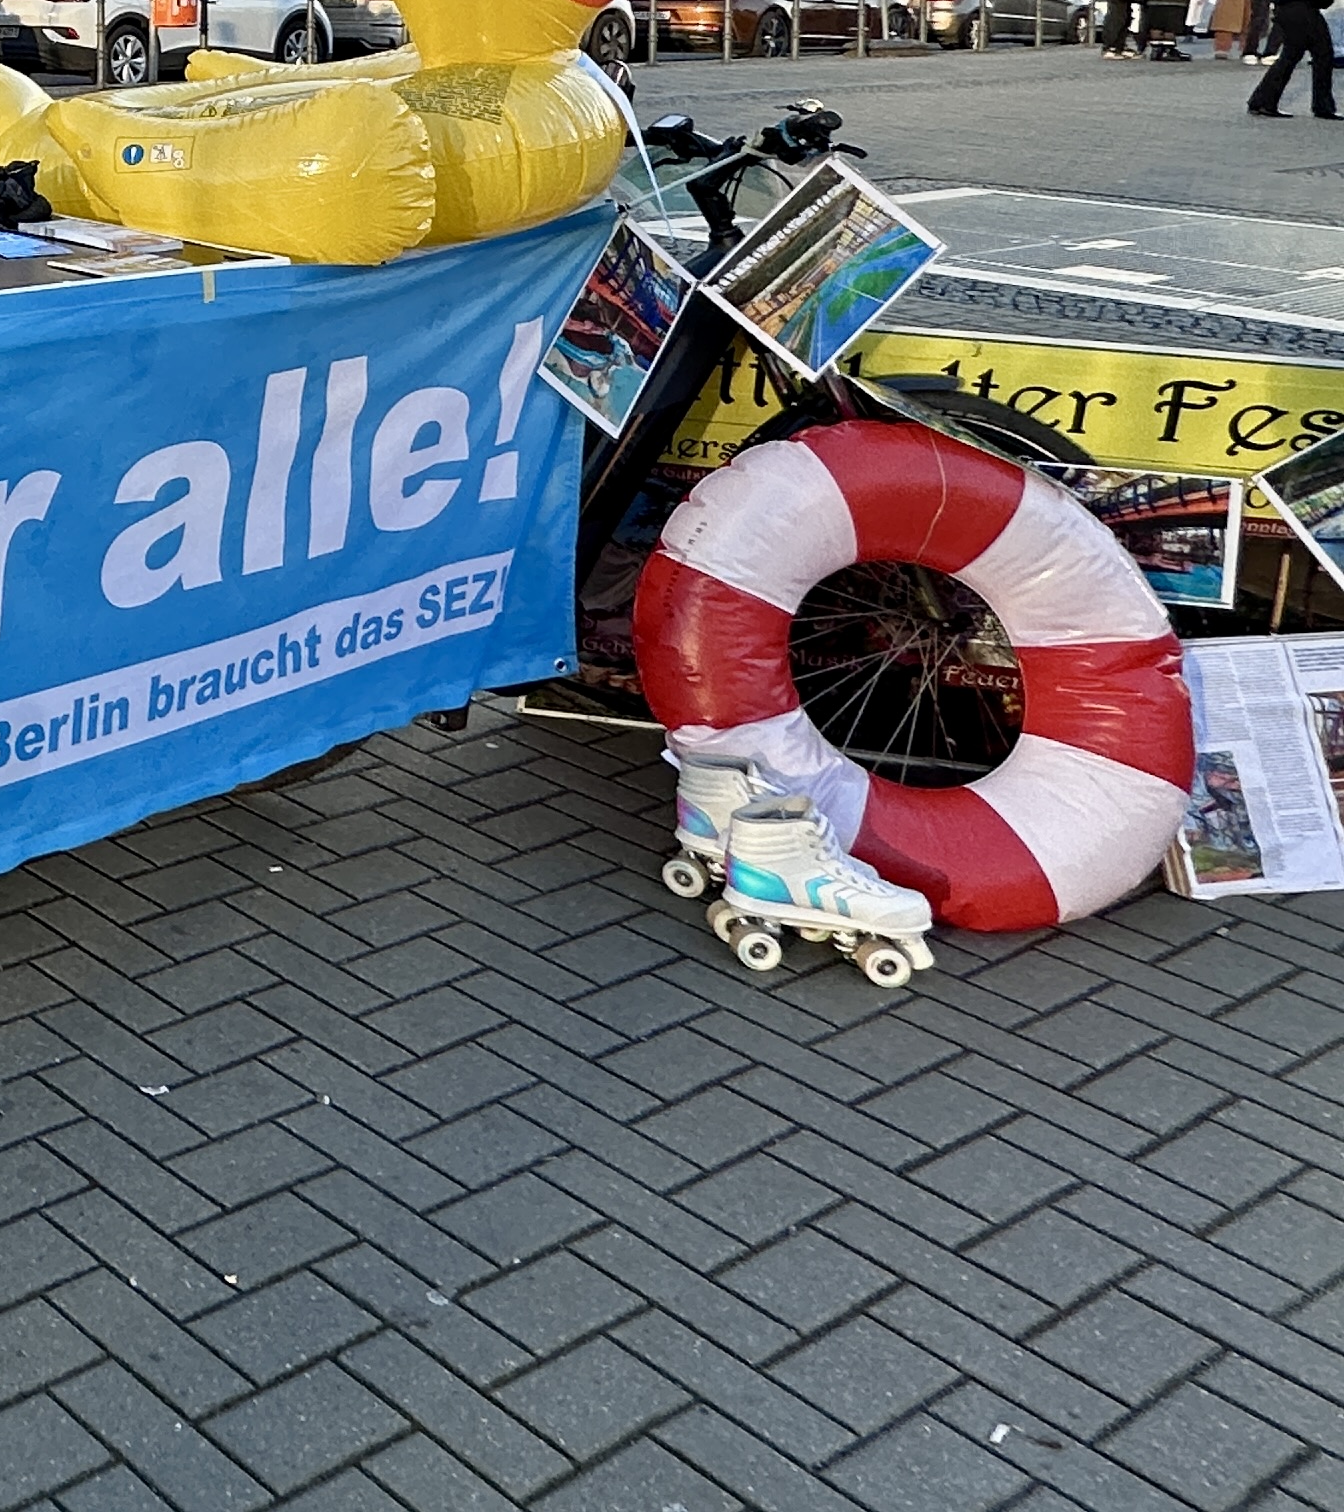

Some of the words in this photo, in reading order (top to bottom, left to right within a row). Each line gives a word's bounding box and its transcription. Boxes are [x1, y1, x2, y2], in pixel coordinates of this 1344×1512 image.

[101, 316, 546, 609] alle!
[146, 623, 322, 724] braucht
[334, 603, 404, 661] das
[415, 564, 508, 629] SEZ!
